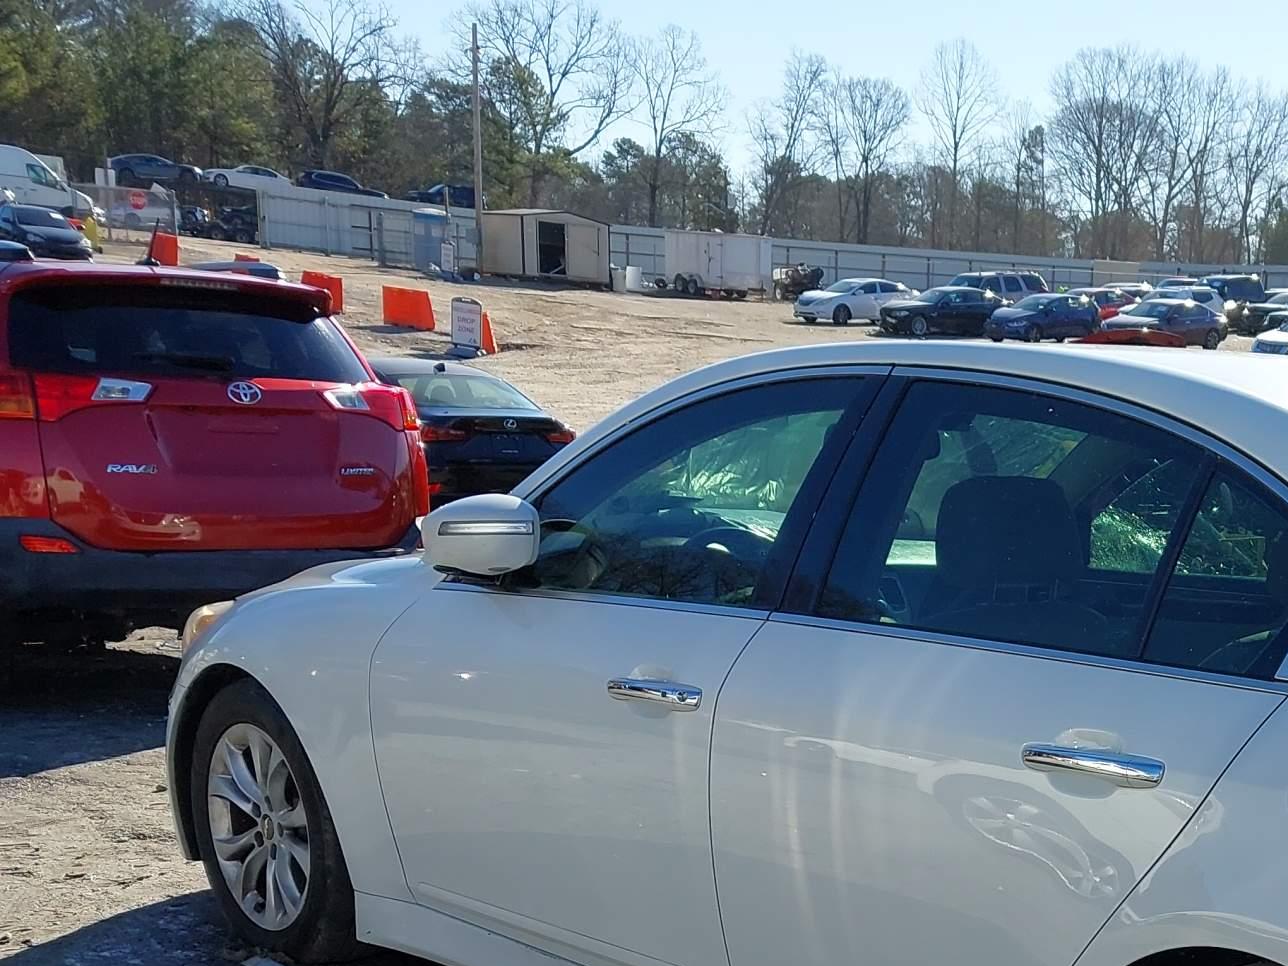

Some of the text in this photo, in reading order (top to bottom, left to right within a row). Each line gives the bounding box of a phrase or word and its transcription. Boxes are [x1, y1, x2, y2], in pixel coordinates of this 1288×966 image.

[457, 315, 476, 325] DROP
[457, 325, 475, 334] ZONE
[106, 464, 158, 474] RAV4
